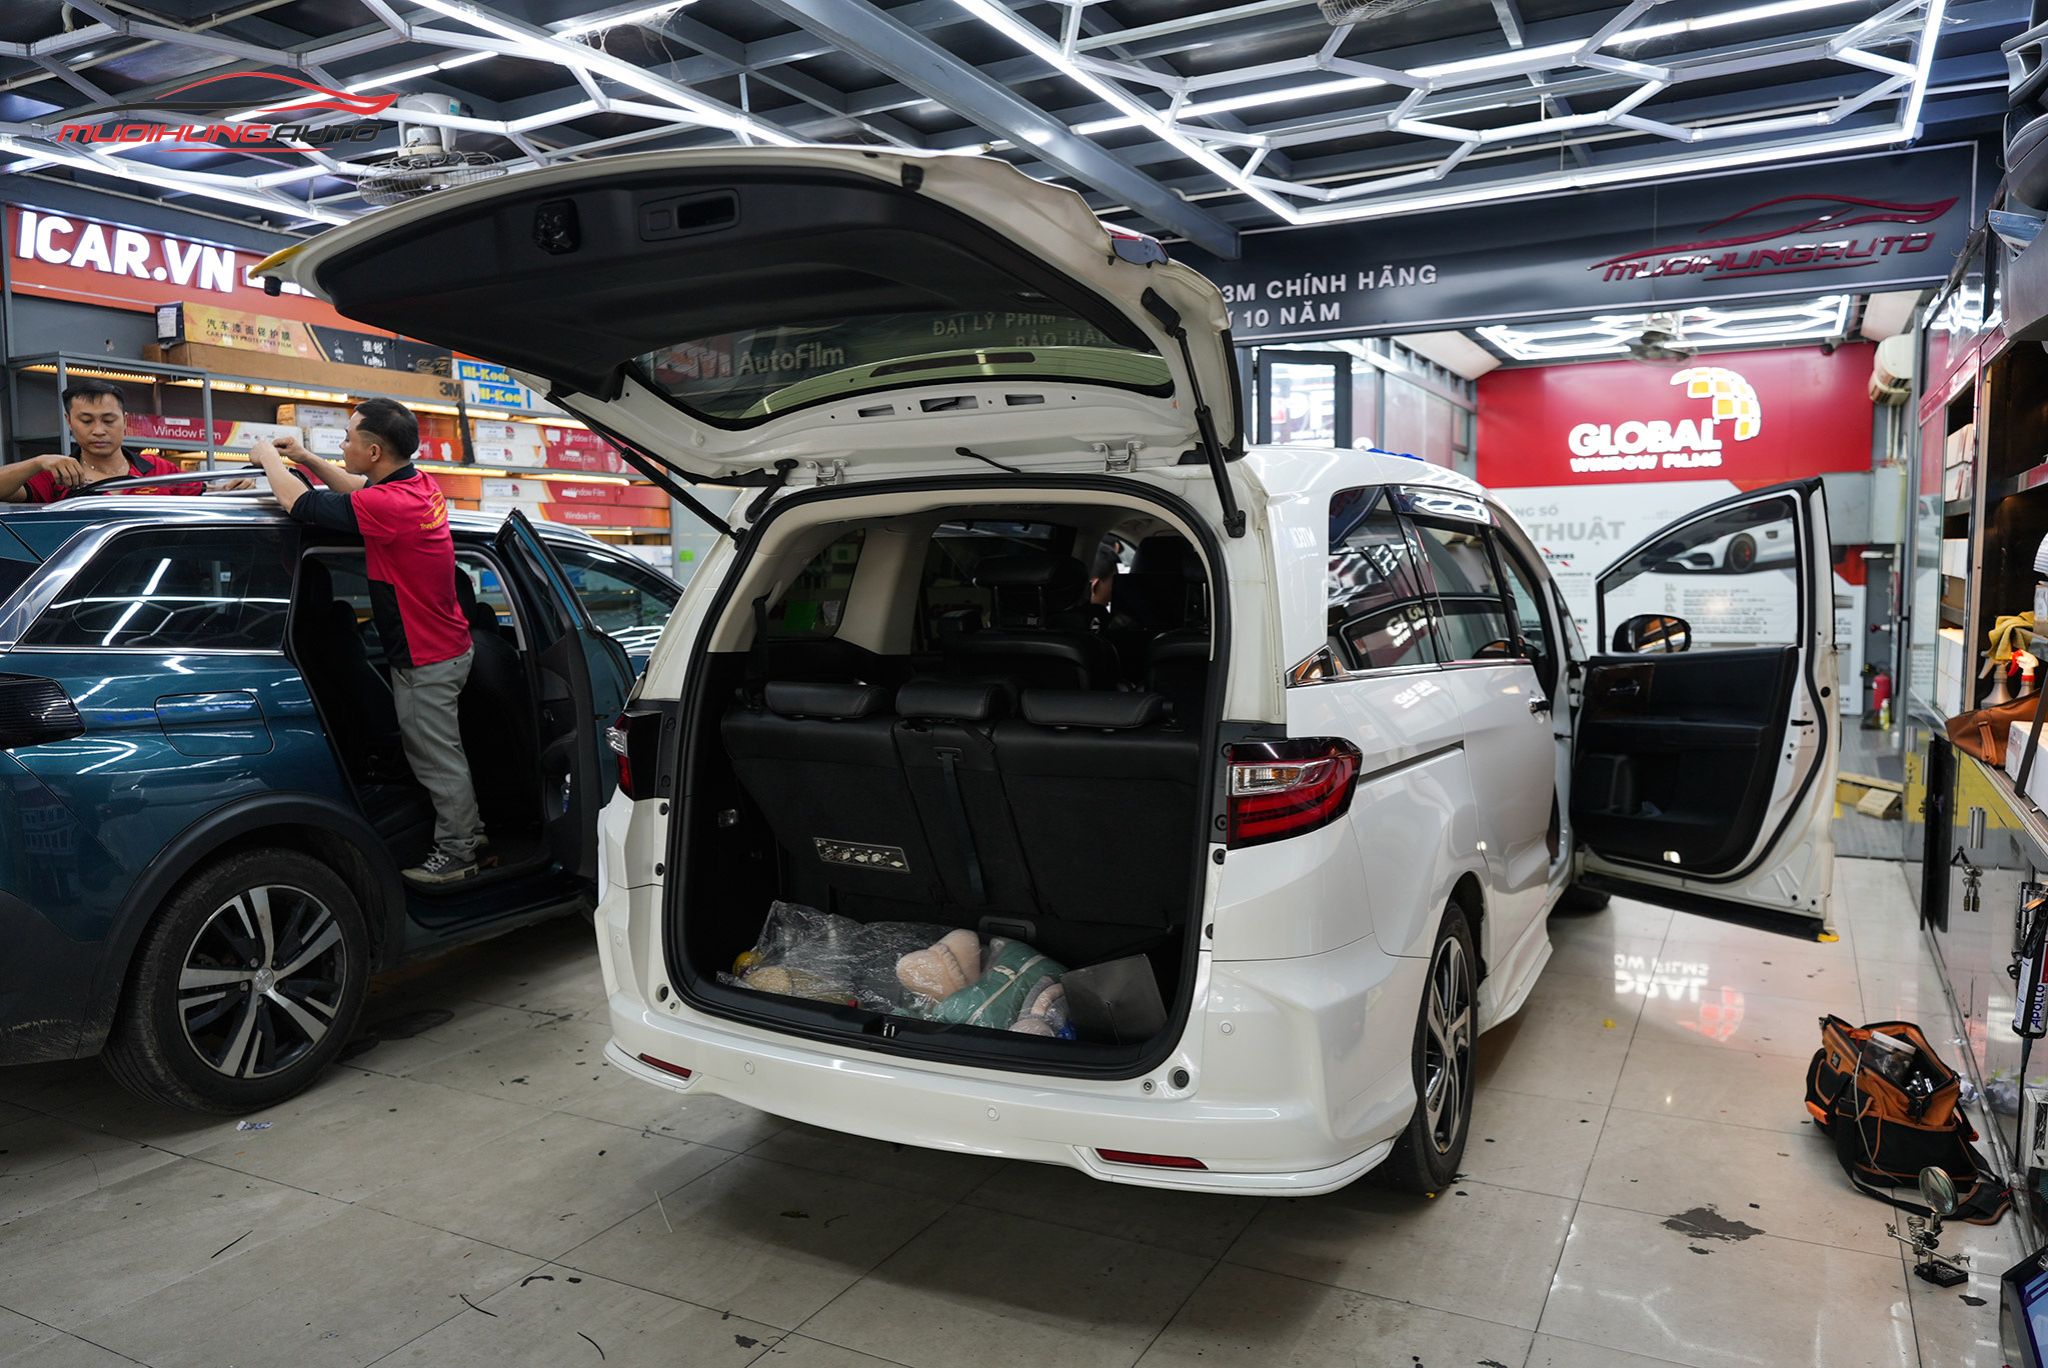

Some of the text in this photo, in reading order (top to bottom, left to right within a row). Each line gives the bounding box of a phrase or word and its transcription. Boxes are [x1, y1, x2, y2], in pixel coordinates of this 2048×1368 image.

[18, 211, 236, 293] ICAR.VN
[1222, 264, 1438, 303] 3M CHÍNH HÃNG
[1243, 309, 1270, 328] 10
[1280, 300, 1341, 325] NĂM
[739, 341, 845, 375] AutoFilm
[439, 381, 462, 398] 3M
[153, 424, 198, 438] Window
[1568, 418, 1723, 457] GLOBAL
[1527, 516, 1626, 546] THUẬT
[2030, 984, 2046, 1031] APOLLO
